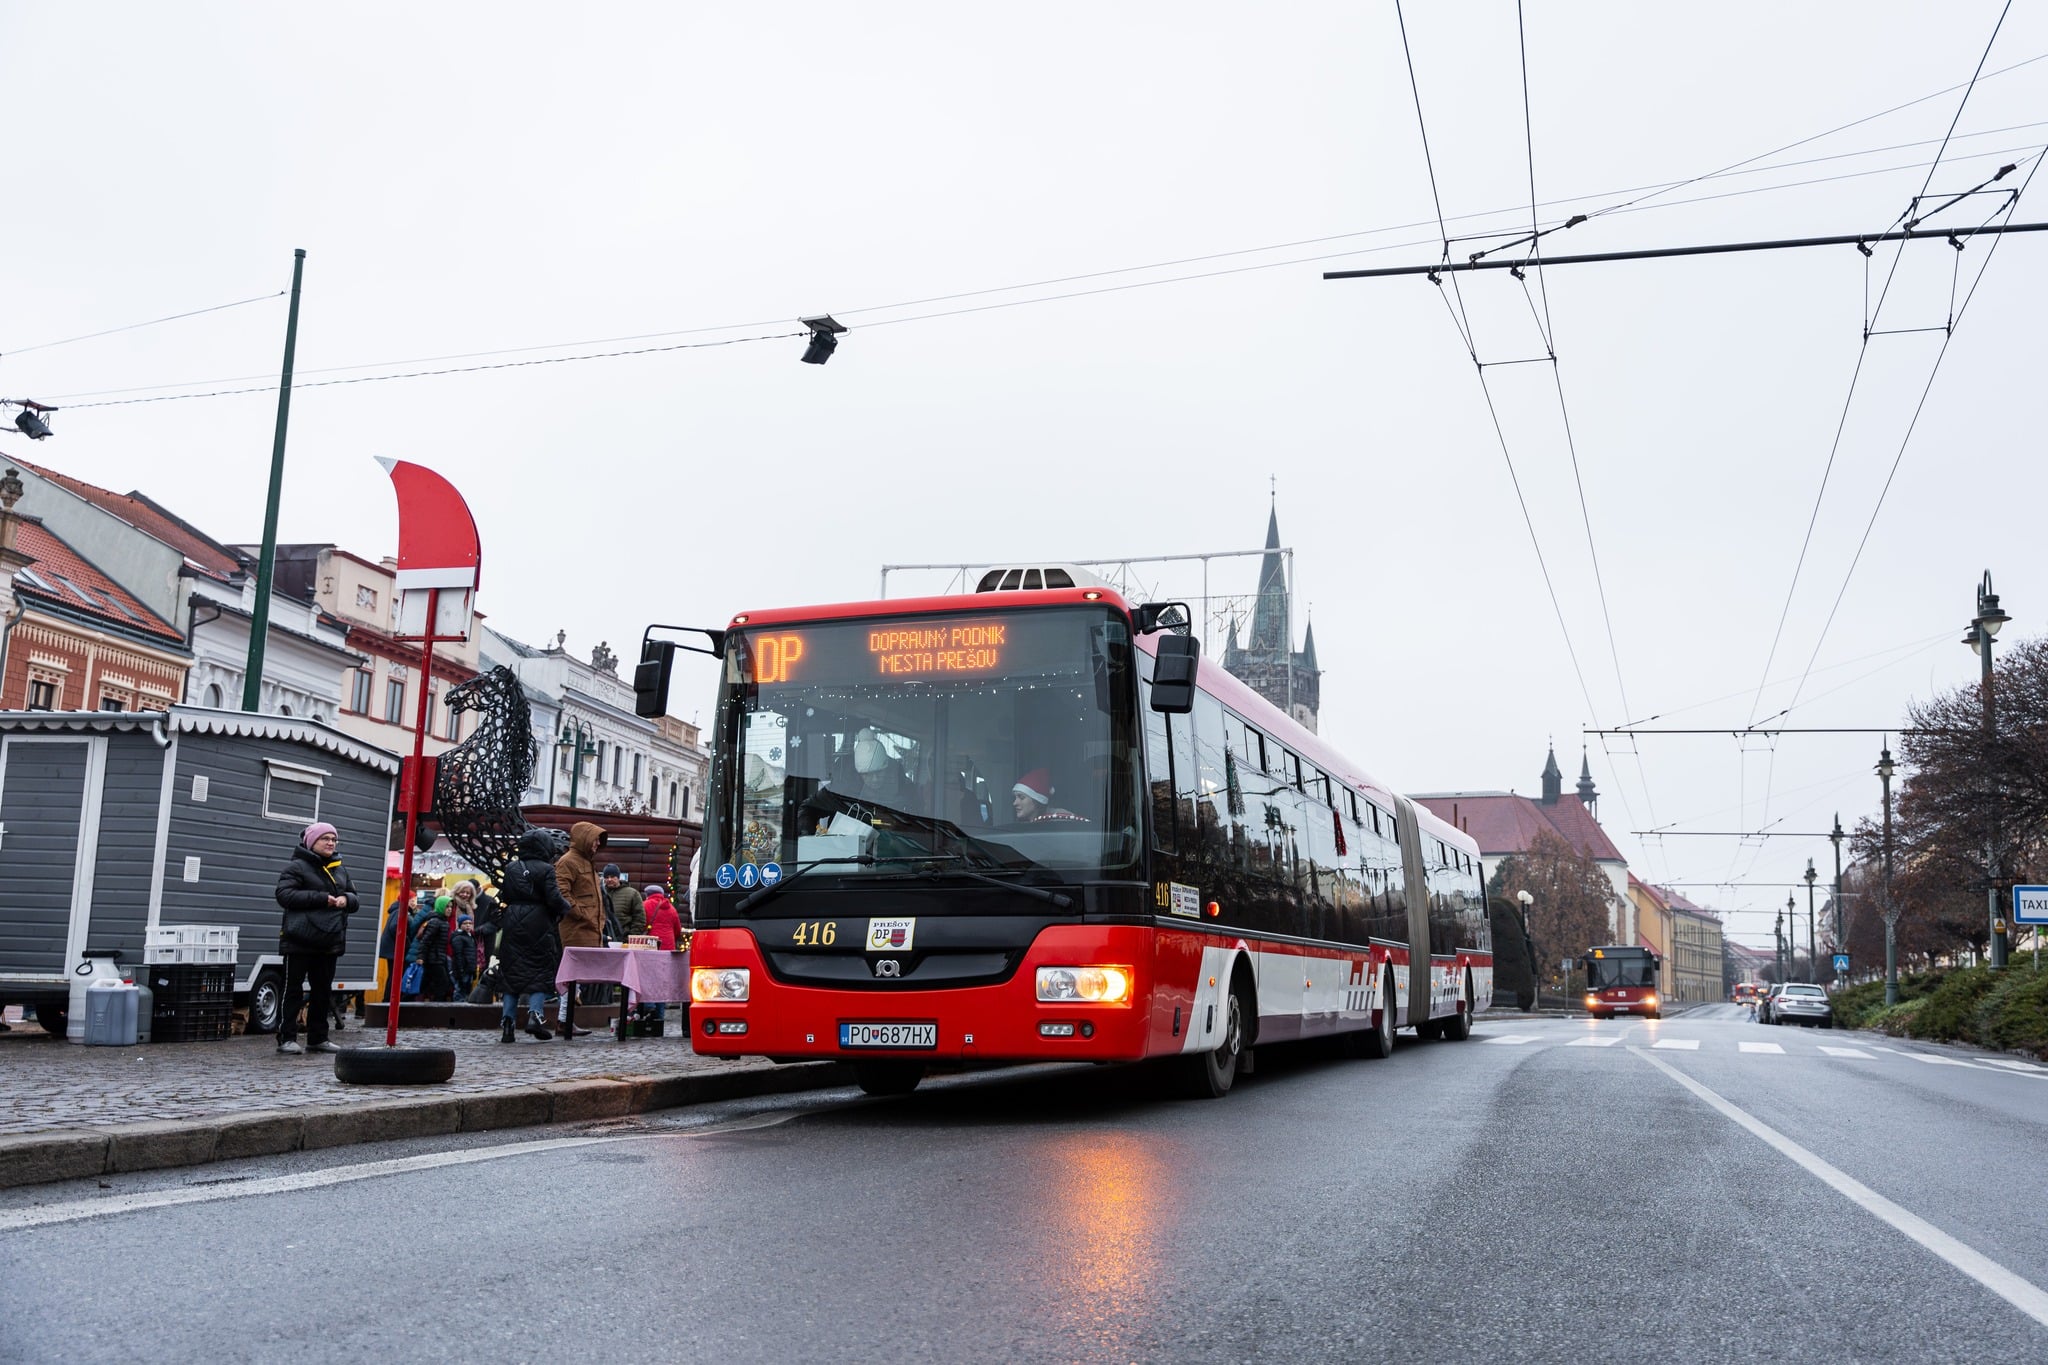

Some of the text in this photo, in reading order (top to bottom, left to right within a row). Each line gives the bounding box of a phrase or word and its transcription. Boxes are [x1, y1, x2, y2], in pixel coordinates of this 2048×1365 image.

[870, 626, 1006, 652] DOPRAVNÝ PODNIK
[757, 636, 803, 683] DP
[880, 653, 933, 673] MESTA
[1155, 881, 1169, 907] 416
[2021, 899, 2048, 910] TAXI
[793, 921, 837, 946] 416
[873, 920, 911, 928] PREŠOV
[874, 928, 890, 940] DP
